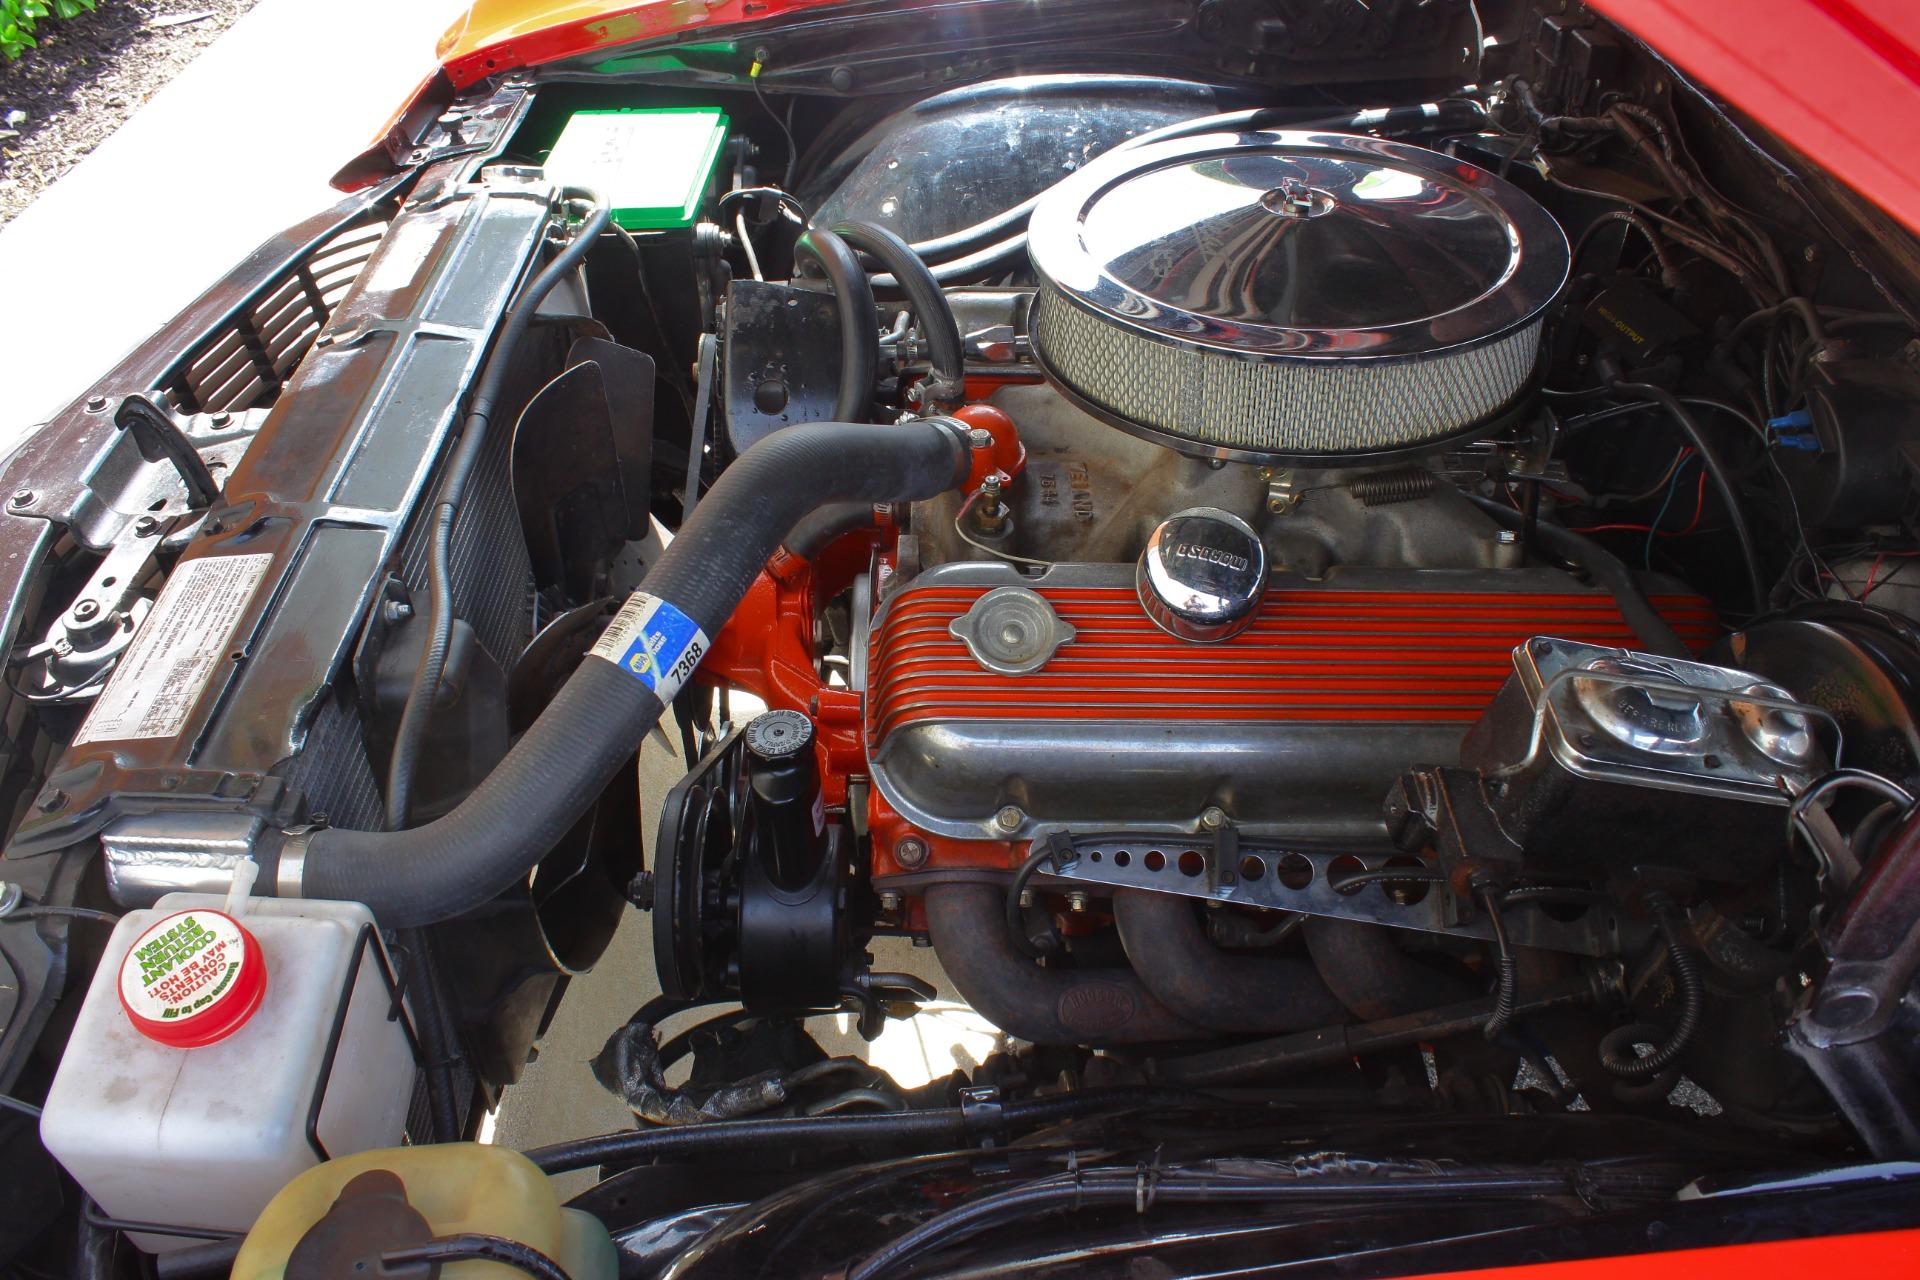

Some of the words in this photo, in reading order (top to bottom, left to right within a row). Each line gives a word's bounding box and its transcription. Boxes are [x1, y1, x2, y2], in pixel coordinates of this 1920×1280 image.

[671, 642, 703, 685] 7368
[134, 916, 196, 962] SYSTEM
[139, 924, 206, 973] RETURN
[202, 940, 227, 964] MAY
[141, 930, 217, 988] COOLANT
[159, 952, 226, 1001] CONTENTS
[181, 961, 199, 977] BE
[148, 974, 180, 998] HOT!
[168, 962, 227, 1004] CAUTION:
[211, 961, 240, 996] Remove
[162, 1007, 180, 1019] Fill
[181, 1005, 193, 1014] to
[193, 994, 213, 1009] Cap
